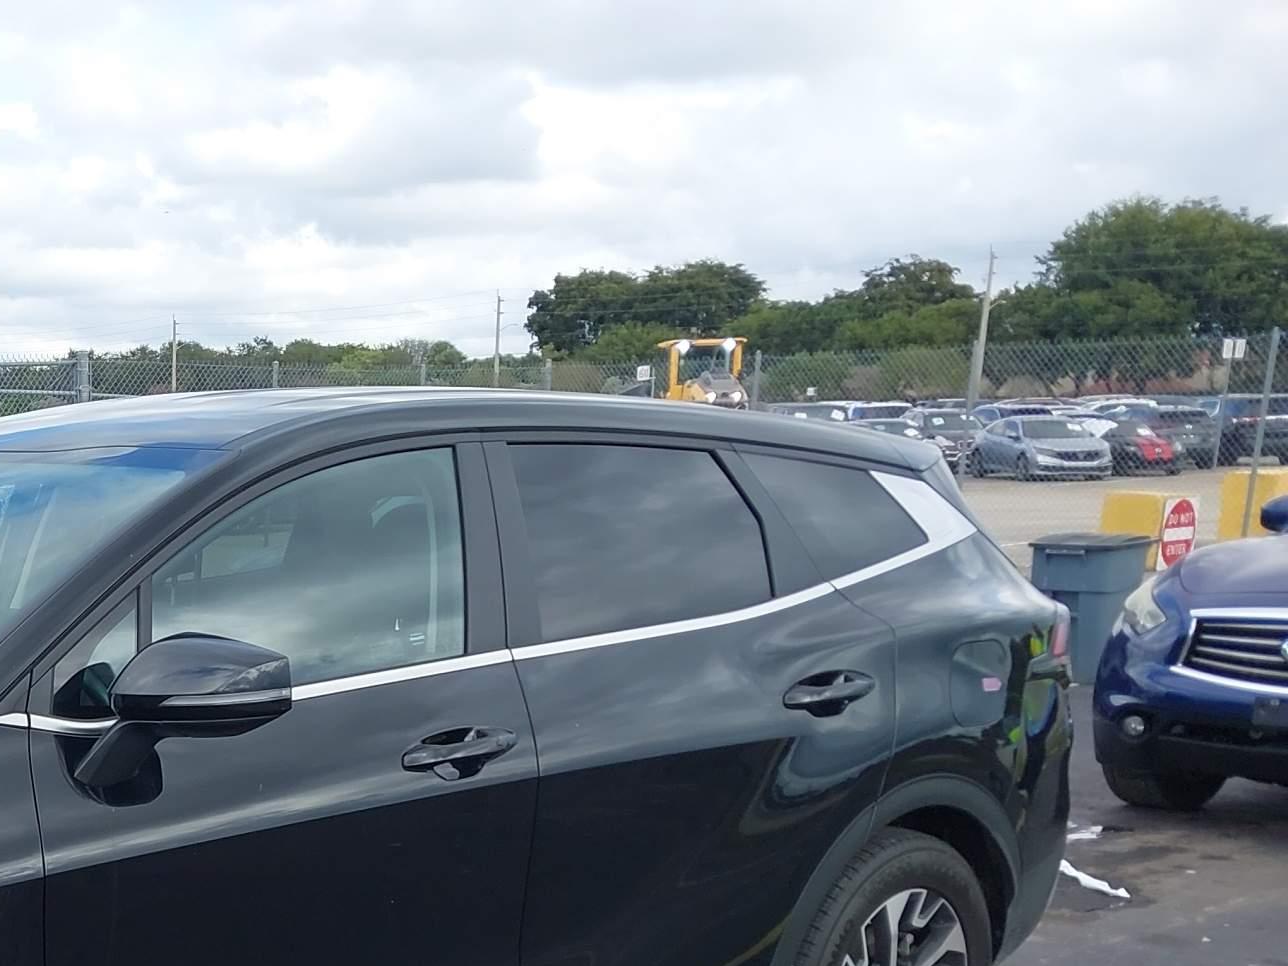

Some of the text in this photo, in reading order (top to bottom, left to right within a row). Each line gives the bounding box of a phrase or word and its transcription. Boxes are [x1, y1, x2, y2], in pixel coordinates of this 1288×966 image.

[1169, 511, 1193, 525] DO NOT
[1167, 543, 1187, 556] ENTER
